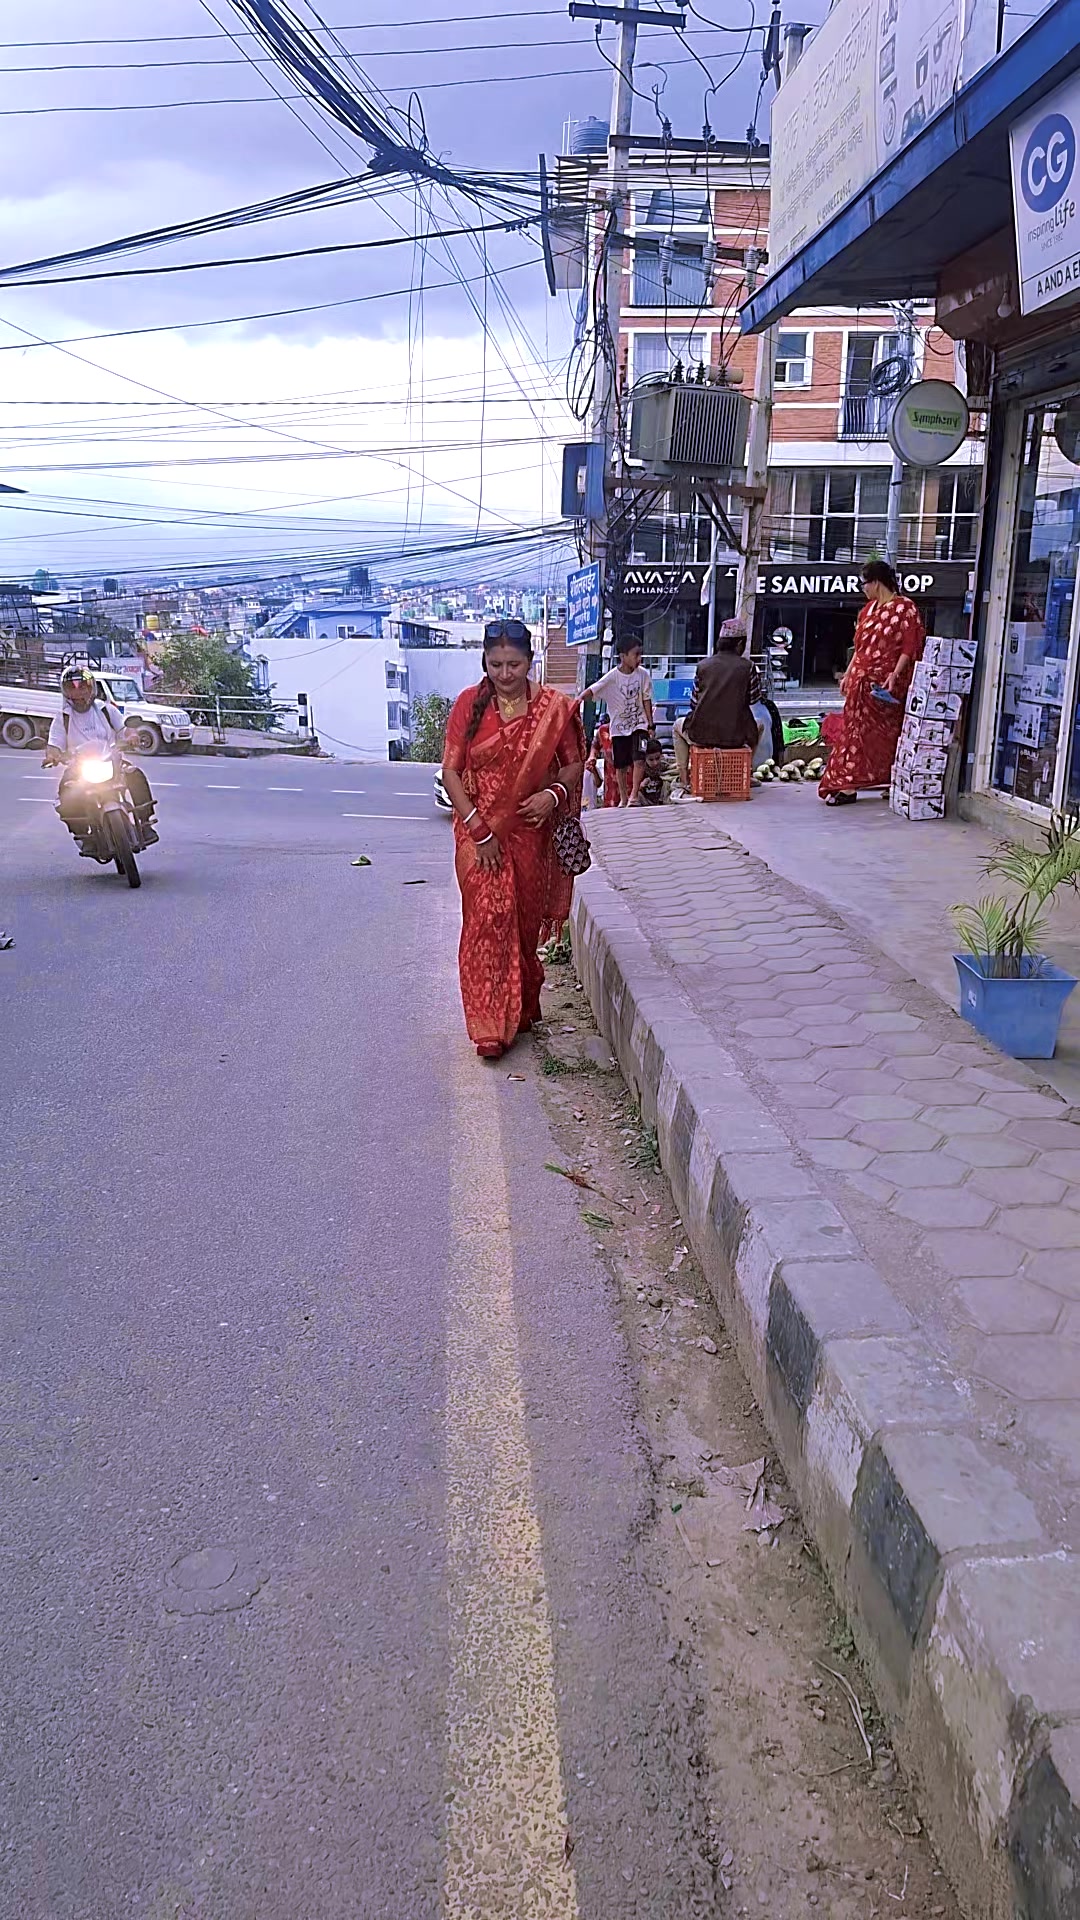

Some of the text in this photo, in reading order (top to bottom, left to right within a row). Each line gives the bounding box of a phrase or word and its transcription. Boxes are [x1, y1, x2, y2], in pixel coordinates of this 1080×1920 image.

[1027, 131, 1068, 196] CG
[1054, 199, 1075, 229] life
[1037, 280, 1044, 298] A
[1045, 269, 1063, 294] AND
[1065, 265, 1072, 284] A
[912, 411, 959, 428] Symphony
[624, 571, 696, 584] AVATA
[623, 586, 679, 594] APPLIANCES
